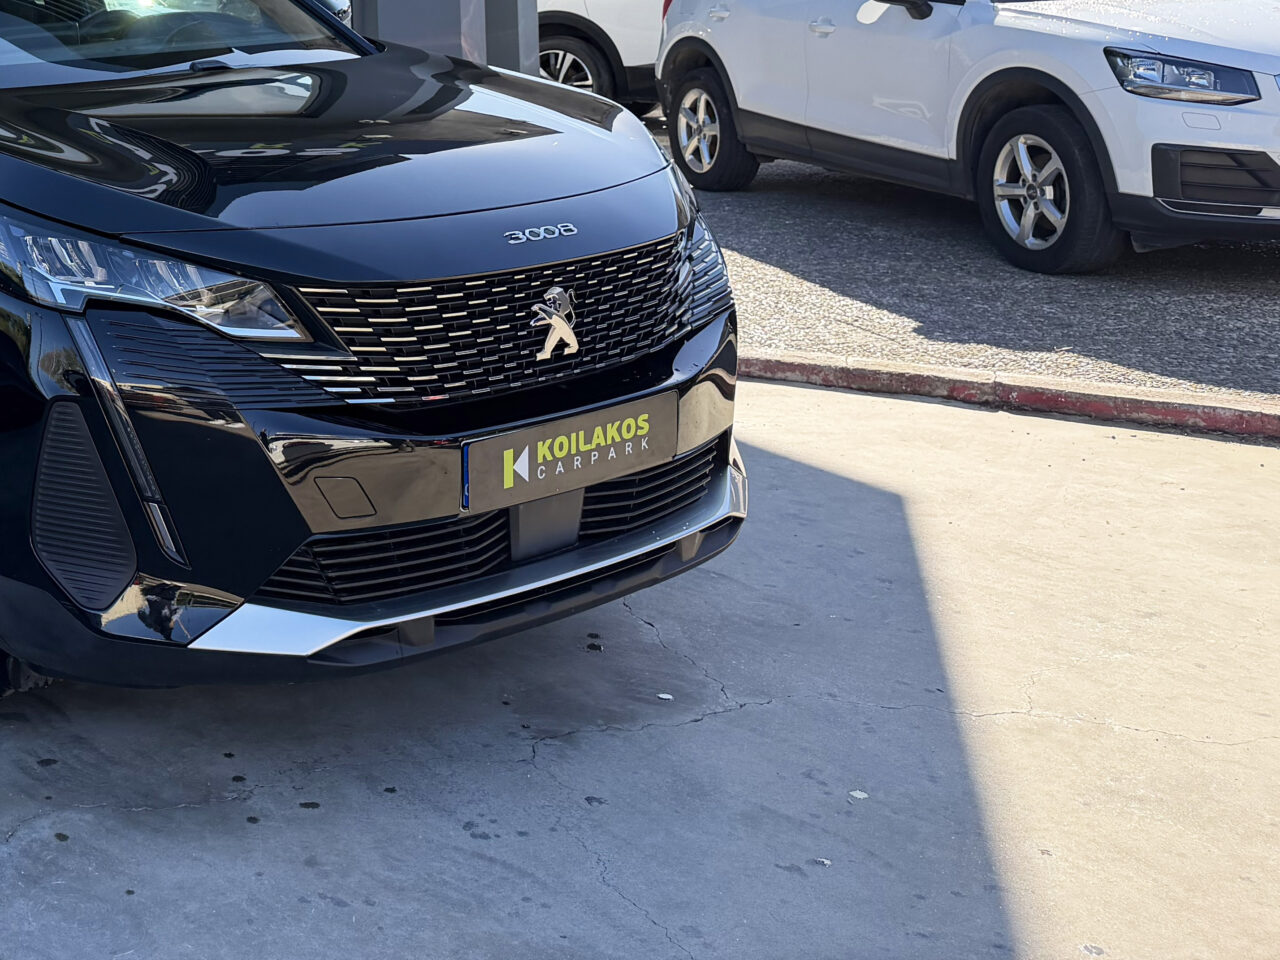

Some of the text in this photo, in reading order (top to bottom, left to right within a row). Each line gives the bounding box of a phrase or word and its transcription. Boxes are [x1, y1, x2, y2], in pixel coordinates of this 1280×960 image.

[504, 223, 578, 245] 3008
[536, 413, 650, 464] KOILAKOS
[537, 436, 650, 480] CARPARK
